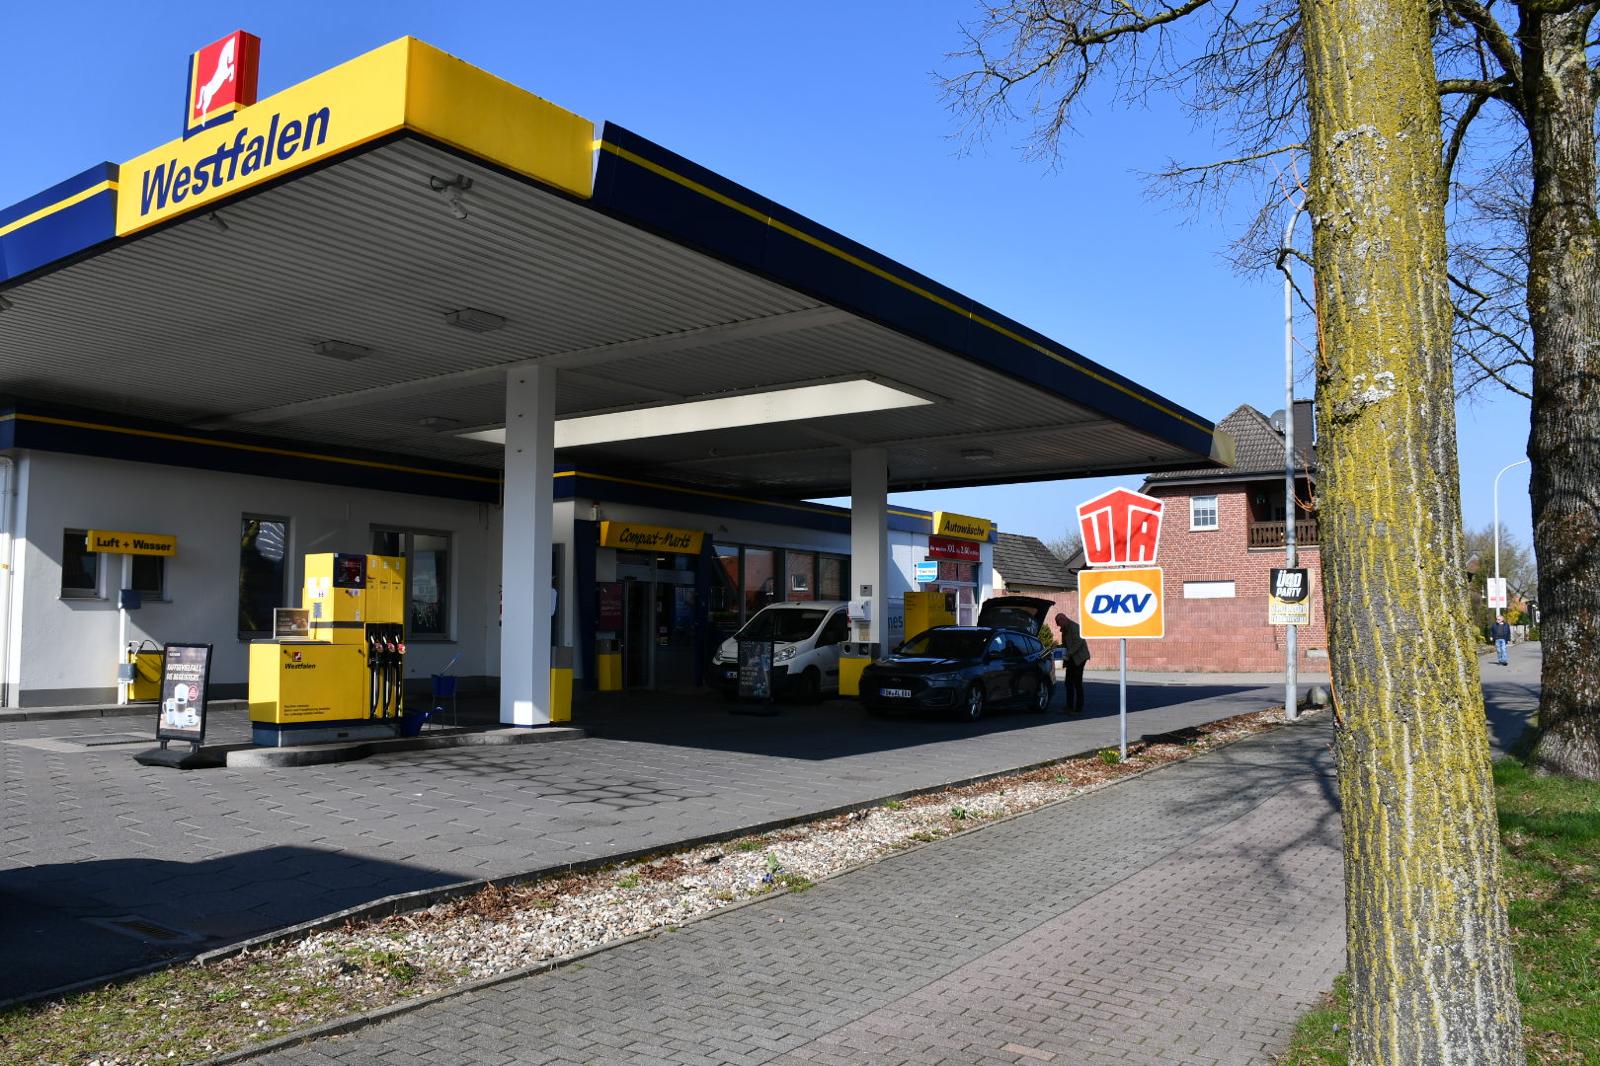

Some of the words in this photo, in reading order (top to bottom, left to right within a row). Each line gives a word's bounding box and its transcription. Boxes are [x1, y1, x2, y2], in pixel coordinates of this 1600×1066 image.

[140, 106, 331, 217] Westfalen
[943, 520, 985, 537] Autowäsche
[1079, 490, 1161, 563] UTA
[97, 537, 119, 548] Luft
[133, 539, 172, 551] Wasser
[619, 527, 691, 548] Compact-Markt
[1275, 587, 1302, 598] PARTY
[1091, 593, 1152, 614] DKV
[284, 662, 316, 670] Westfalen
